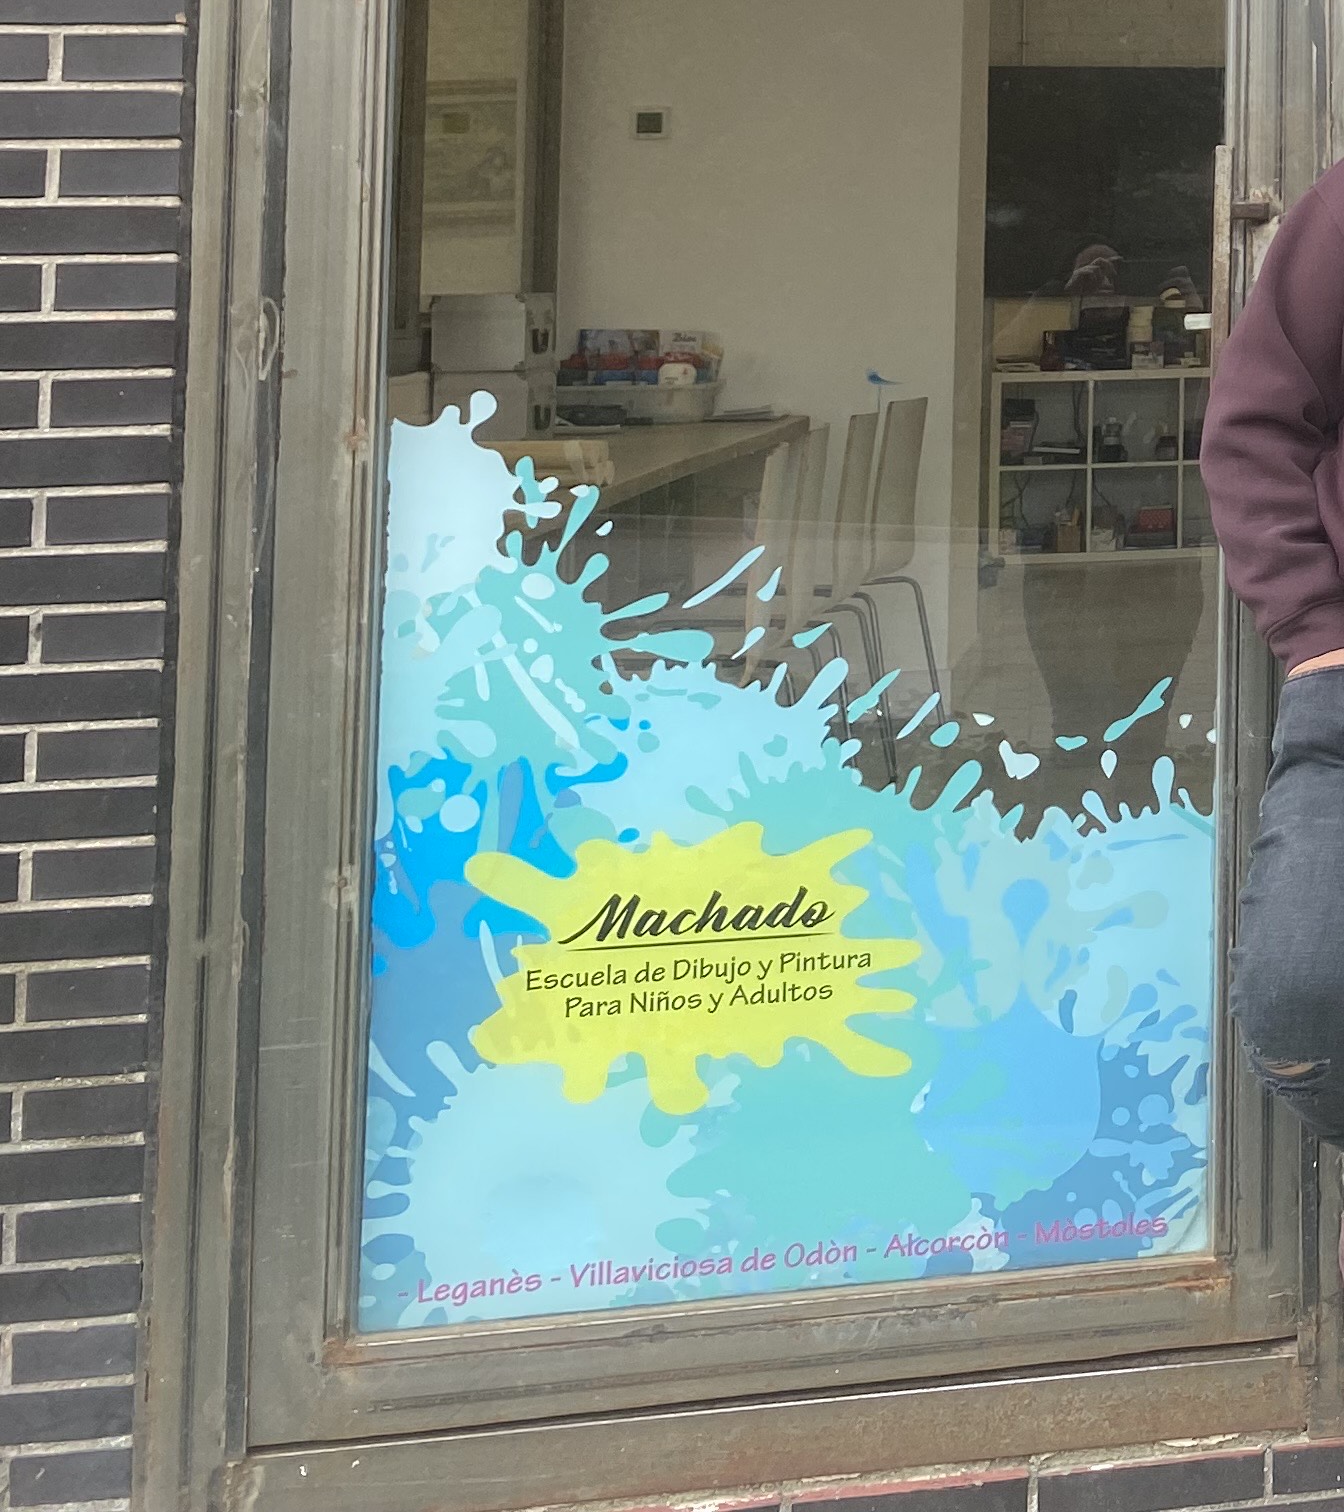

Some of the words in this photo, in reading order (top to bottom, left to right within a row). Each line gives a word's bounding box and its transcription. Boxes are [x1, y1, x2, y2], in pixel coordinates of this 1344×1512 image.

[557, 885, 837, 945] Machado
[525, 963, 627, 992] Escuela
[634, 961, 665, 985] de
[673, 956, 751, 986] Dibujo
[759, 959, 774, 977] y
[779, 948, 873, 974] Pintura
[564, 995, 622, 1019] Para
[629, 987, 702, 1014] Niños
[707, 991, 723, 1013] y
[729, 980, 834, 1007] Adultos
[417, 1268, 543, 1307] Leganès
[569, 1254, 734, 1289] Villaviciosa
[739, 1247, 777, 1274] de
[783, 1239, 858, 1270] Odòn
[882, 1225, 1010, 1259] Alcorcòn
[1033, 1211, 1170, 1246] Mòstoles
